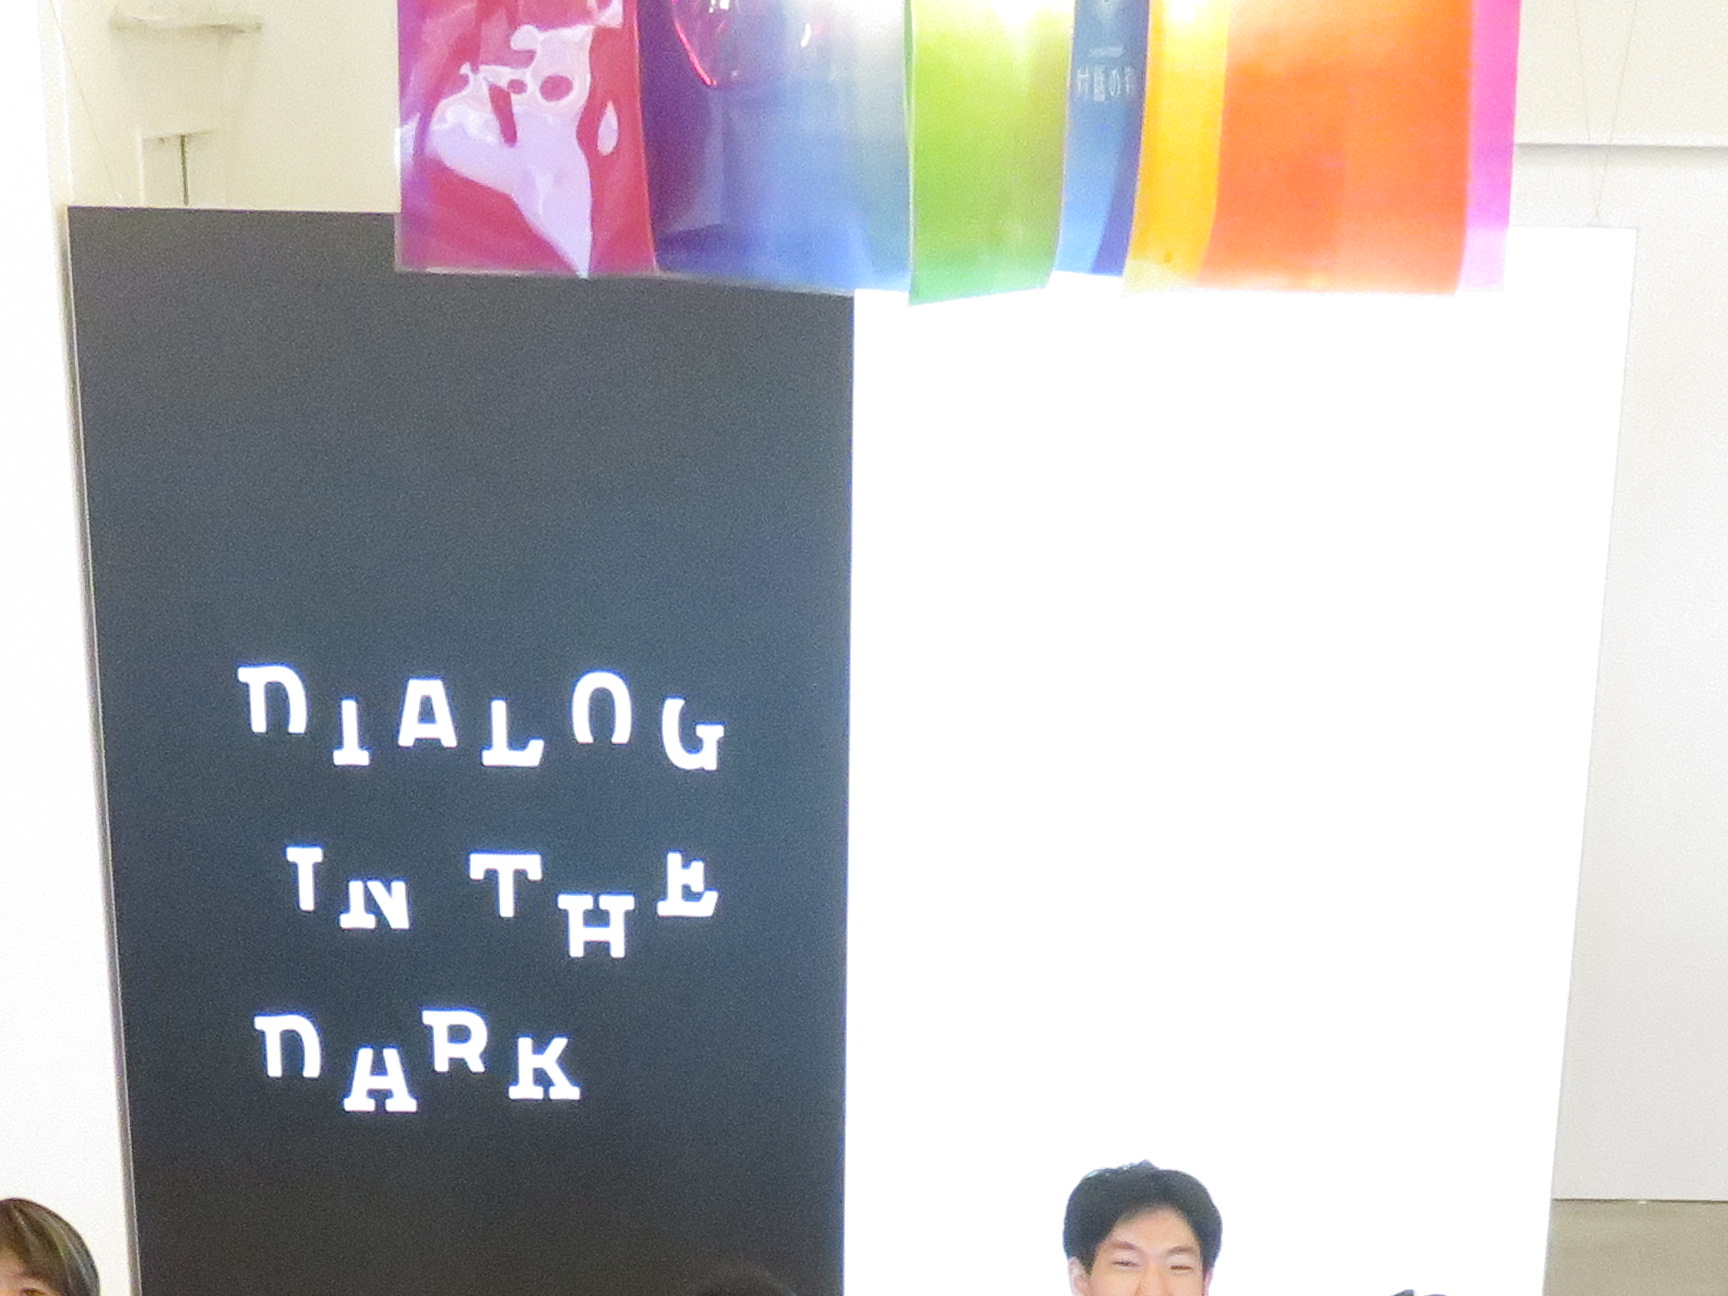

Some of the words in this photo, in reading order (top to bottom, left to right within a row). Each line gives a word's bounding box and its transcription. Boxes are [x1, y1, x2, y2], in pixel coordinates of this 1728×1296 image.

[237, 664, 725, 772] DIALOG
[285, 846, 411, 930] IN
[468, 851, 720, 959] THE
[253, 1009, 581, 1113] DARK
